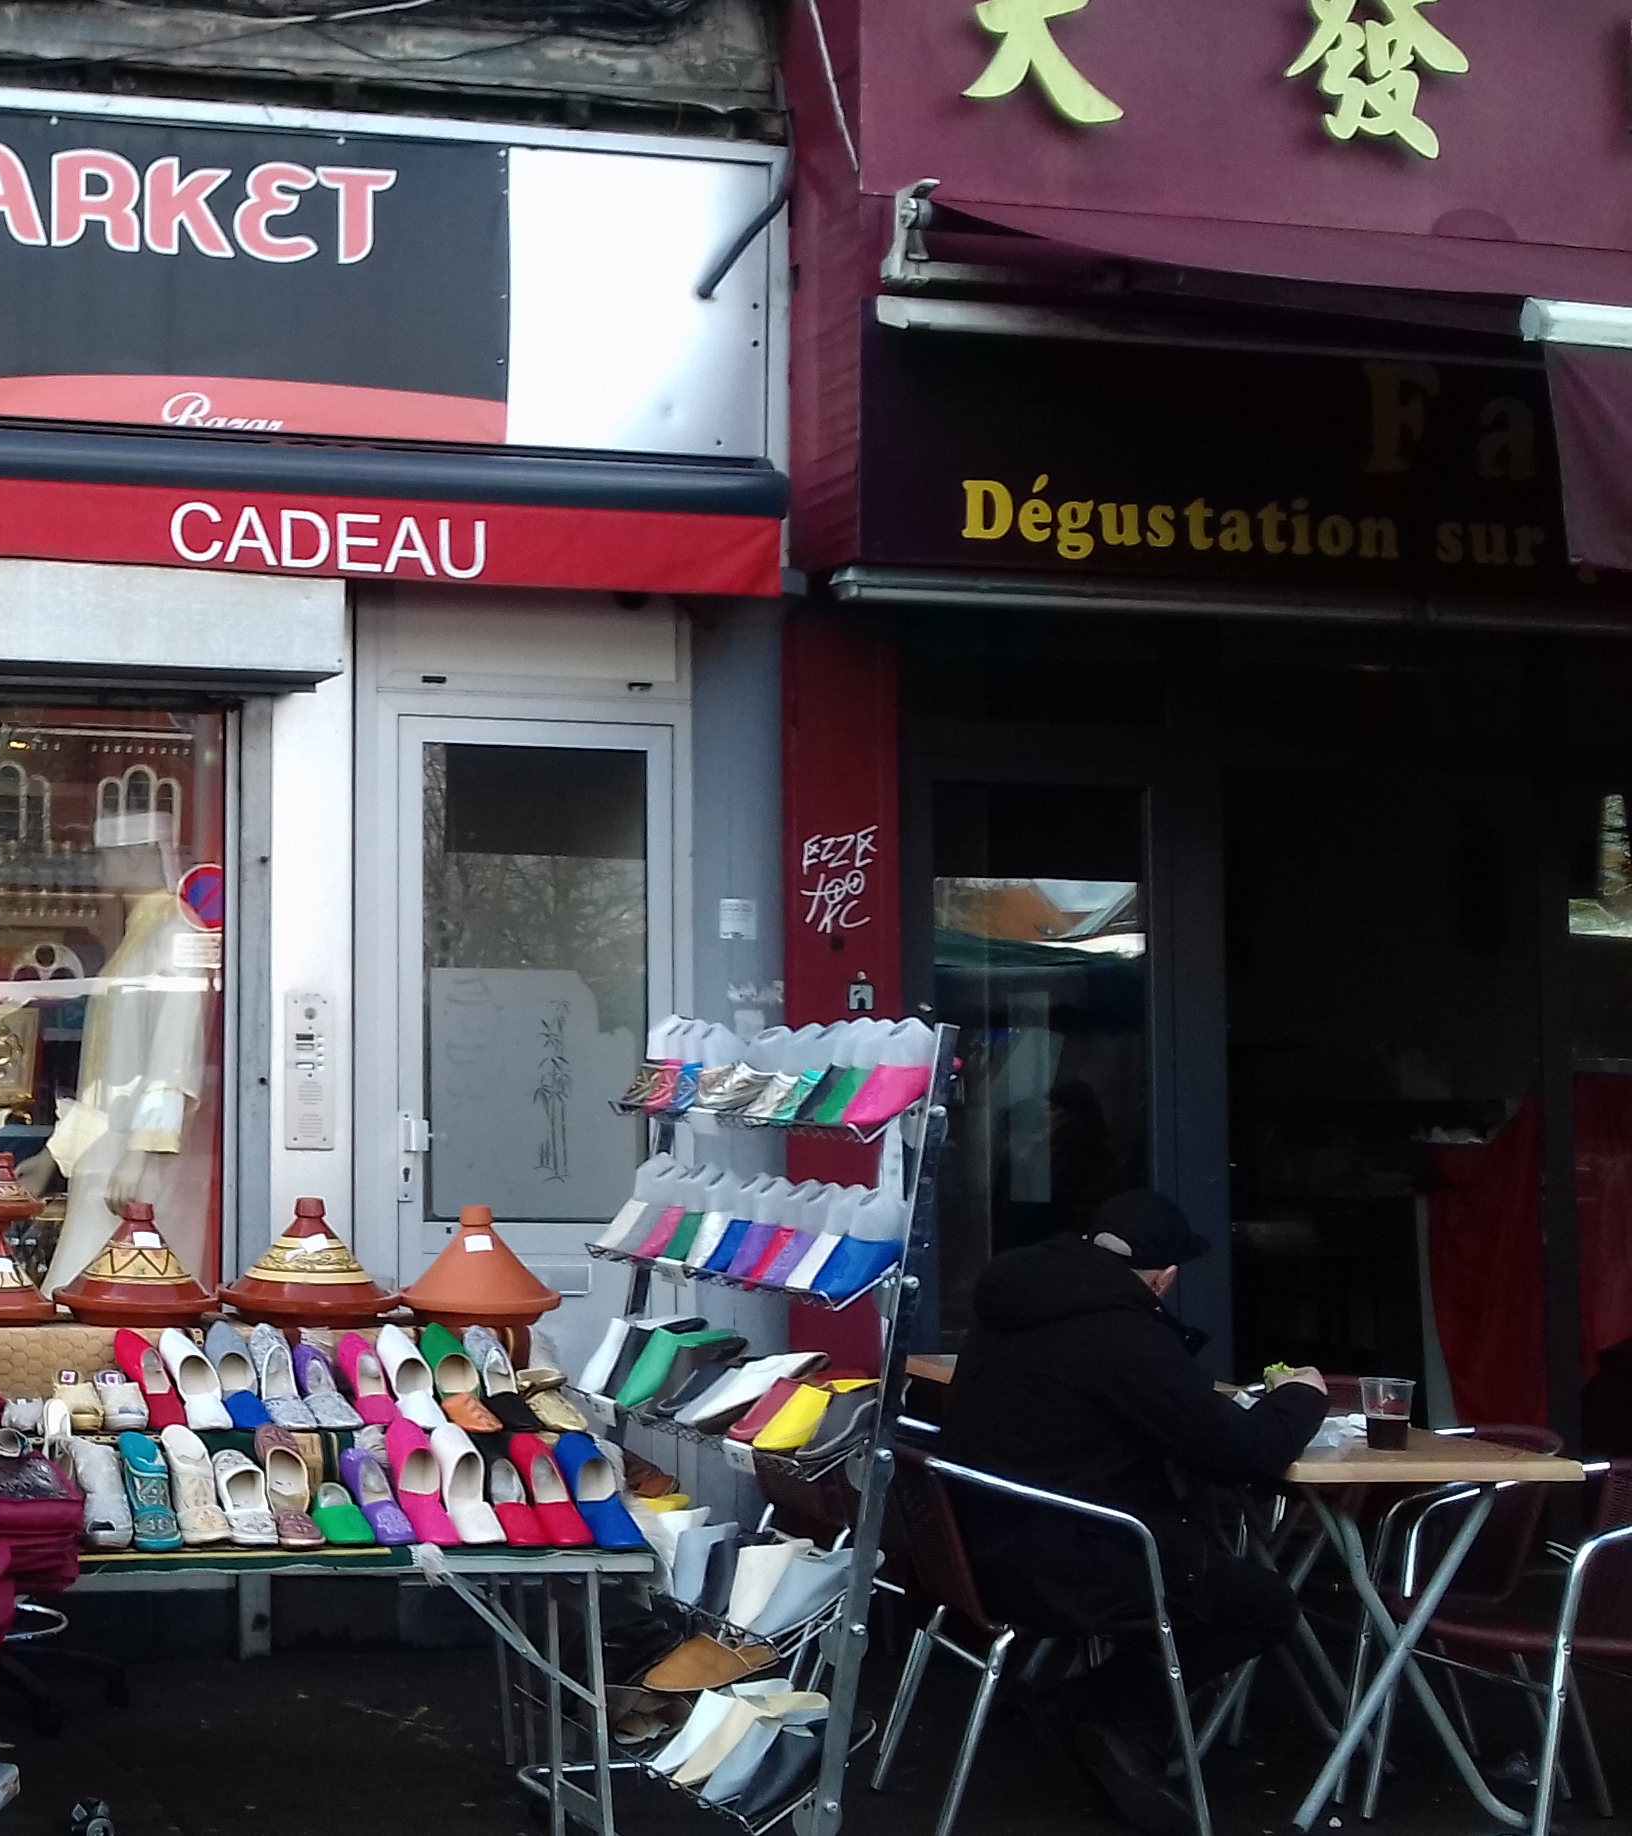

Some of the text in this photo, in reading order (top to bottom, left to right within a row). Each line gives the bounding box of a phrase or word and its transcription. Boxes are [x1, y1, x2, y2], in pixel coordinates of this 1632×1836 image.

[169, 500, 488, 580] CADEAU
[961, 474, 1546, 567] Dégustation sur
